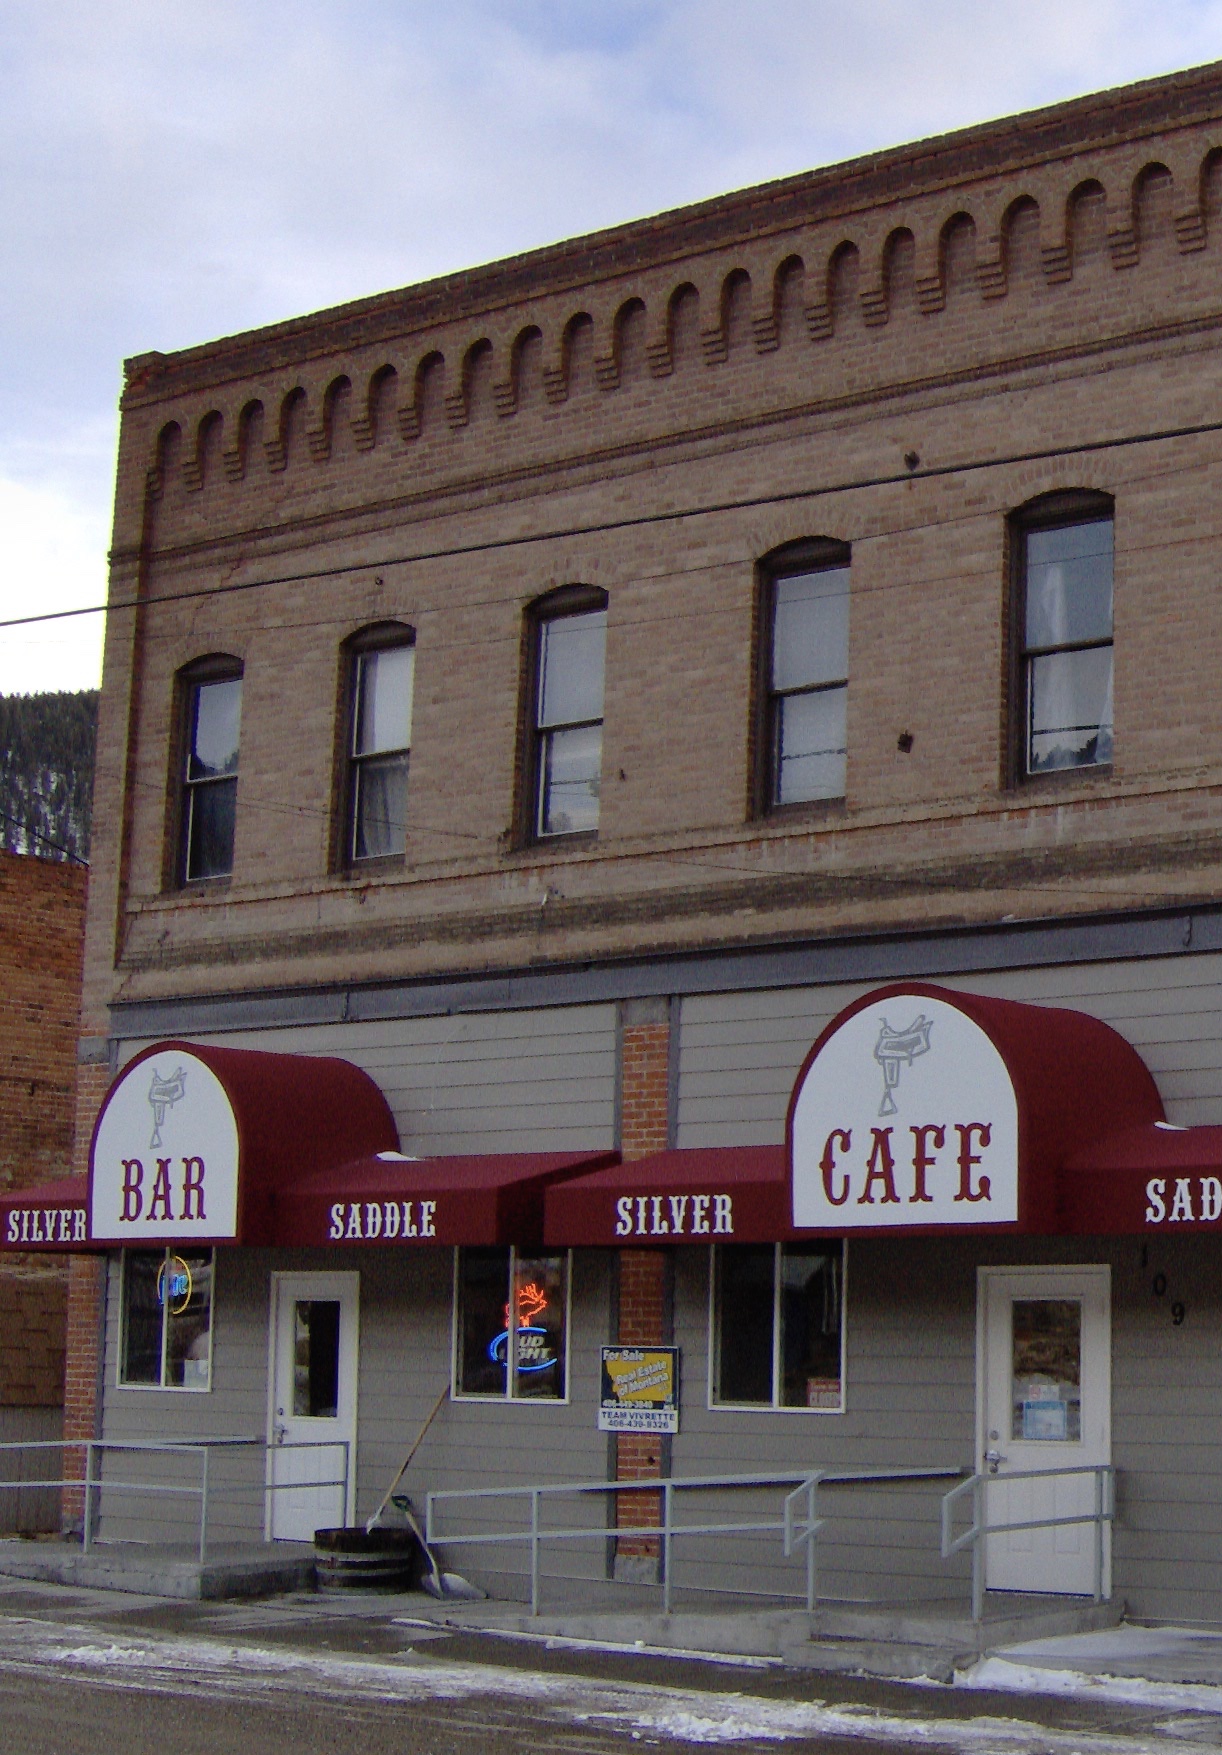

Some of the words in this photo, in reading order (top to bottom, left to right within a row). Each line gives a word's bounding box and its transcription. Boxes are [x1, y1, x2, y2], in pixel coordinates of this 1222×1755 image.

[818, 1122, 993, 1206] CAFE
[118, 1156, 207, 1222] BAR
[7, 1207, 87, 1243] SILVER
[328, 1201, 437, 1240] SADDLE
[616, 1193, 735, 1236] SILVER
[603, 1349, 619, 1361] For
[622, 1349, 645, 1361] Sale
[637, 1361, 667, 1377] Estate
[602, 1411, 627, 1419] TEAM
